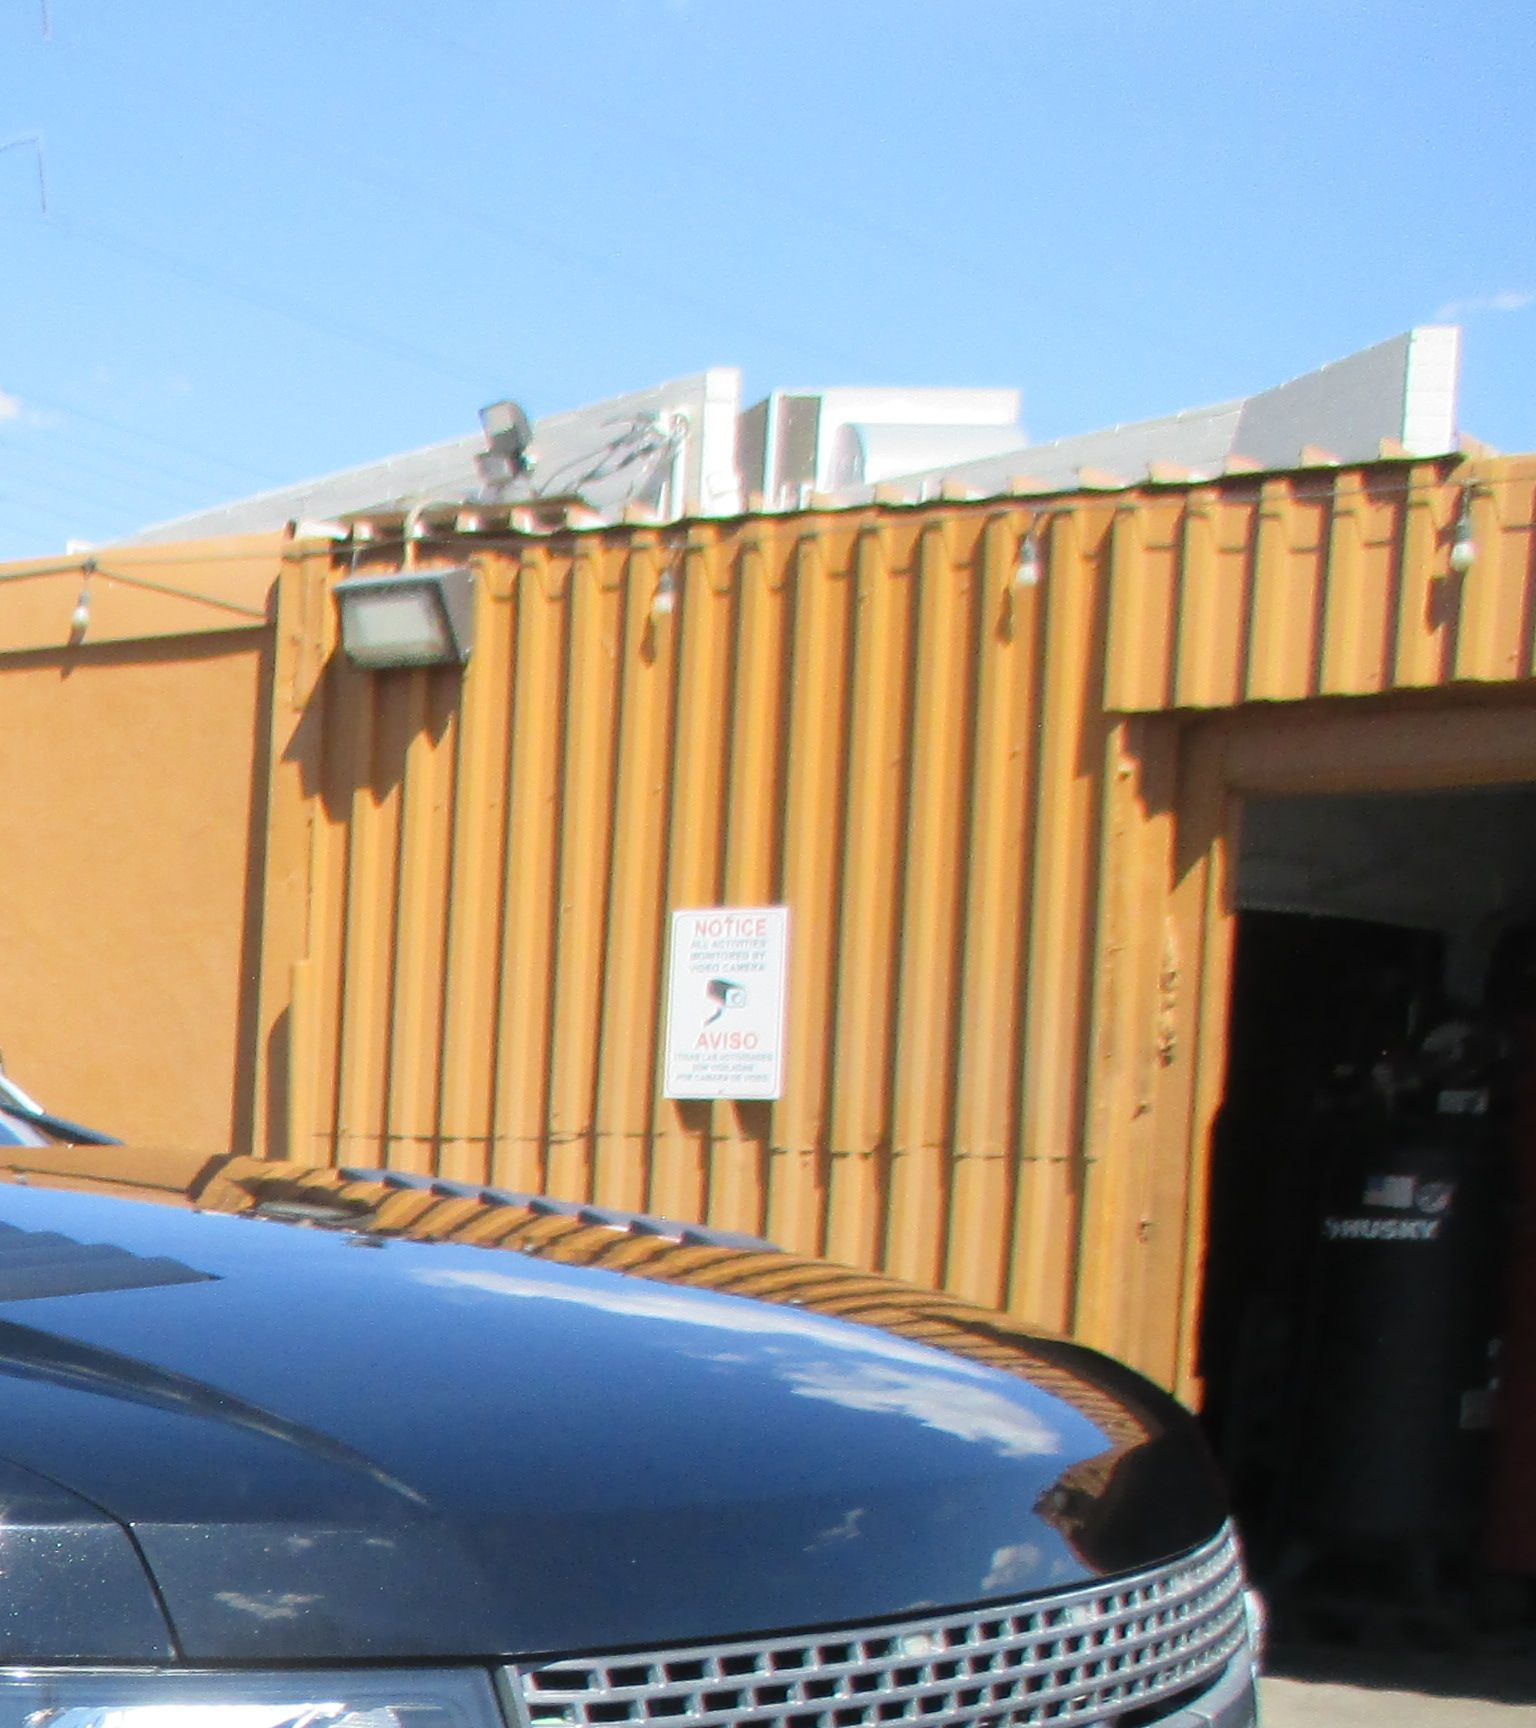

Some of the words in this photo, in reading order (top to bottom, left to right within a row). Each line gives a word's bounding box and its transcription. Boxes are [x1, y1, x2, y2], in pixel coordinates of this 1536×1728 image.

[695, 917, 767, 937] NOTICE
[695, 1032, 759, 1050] AVISO
[1339, 1219, 1439, 1239] HUSKY
